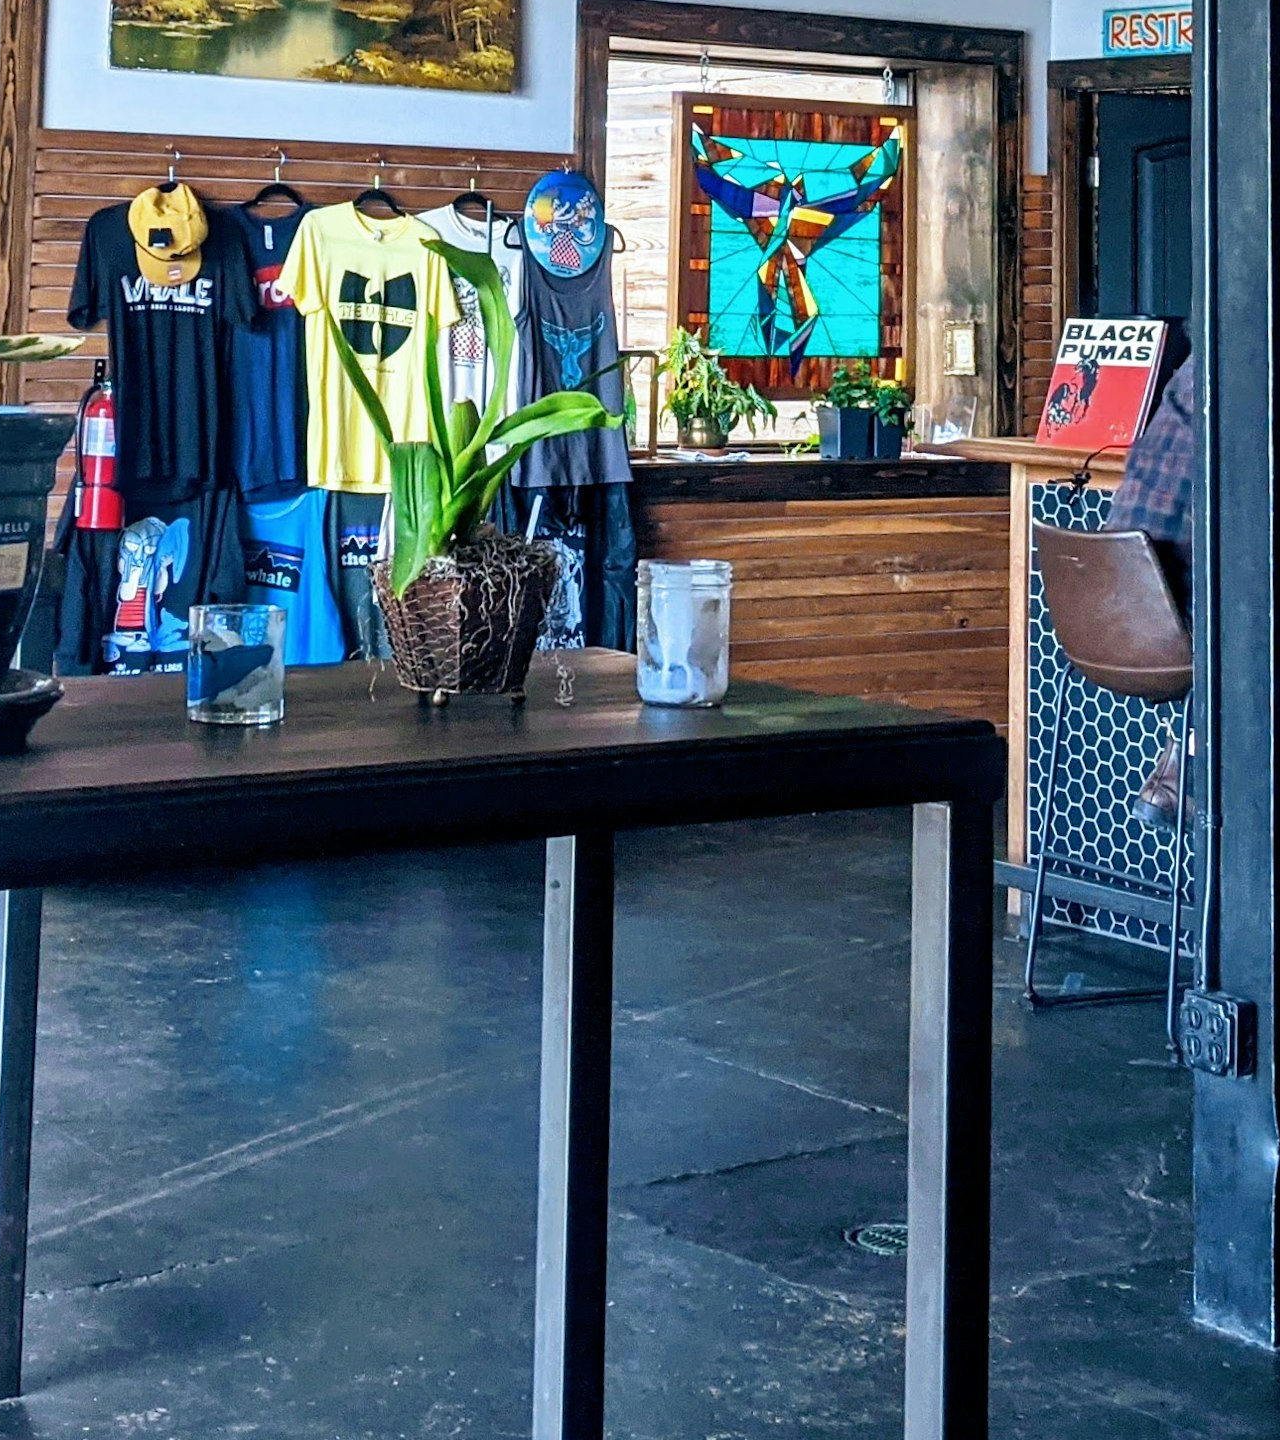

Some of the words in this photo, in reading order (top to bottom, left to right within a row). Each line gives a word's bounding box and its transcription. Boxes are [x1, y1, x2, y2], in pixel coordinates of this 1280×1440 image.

[121, 274, 213, 307] WHALE
[338, 304, 362, 318] THE
[366, 305, 414, 325] WHALE
[1066, 324, 1157, 342] BLACK
[1061, 344, 1152, 361] PUMAS
[341, 552, 368, 566] the
[246, 569, 292, 588] whale
